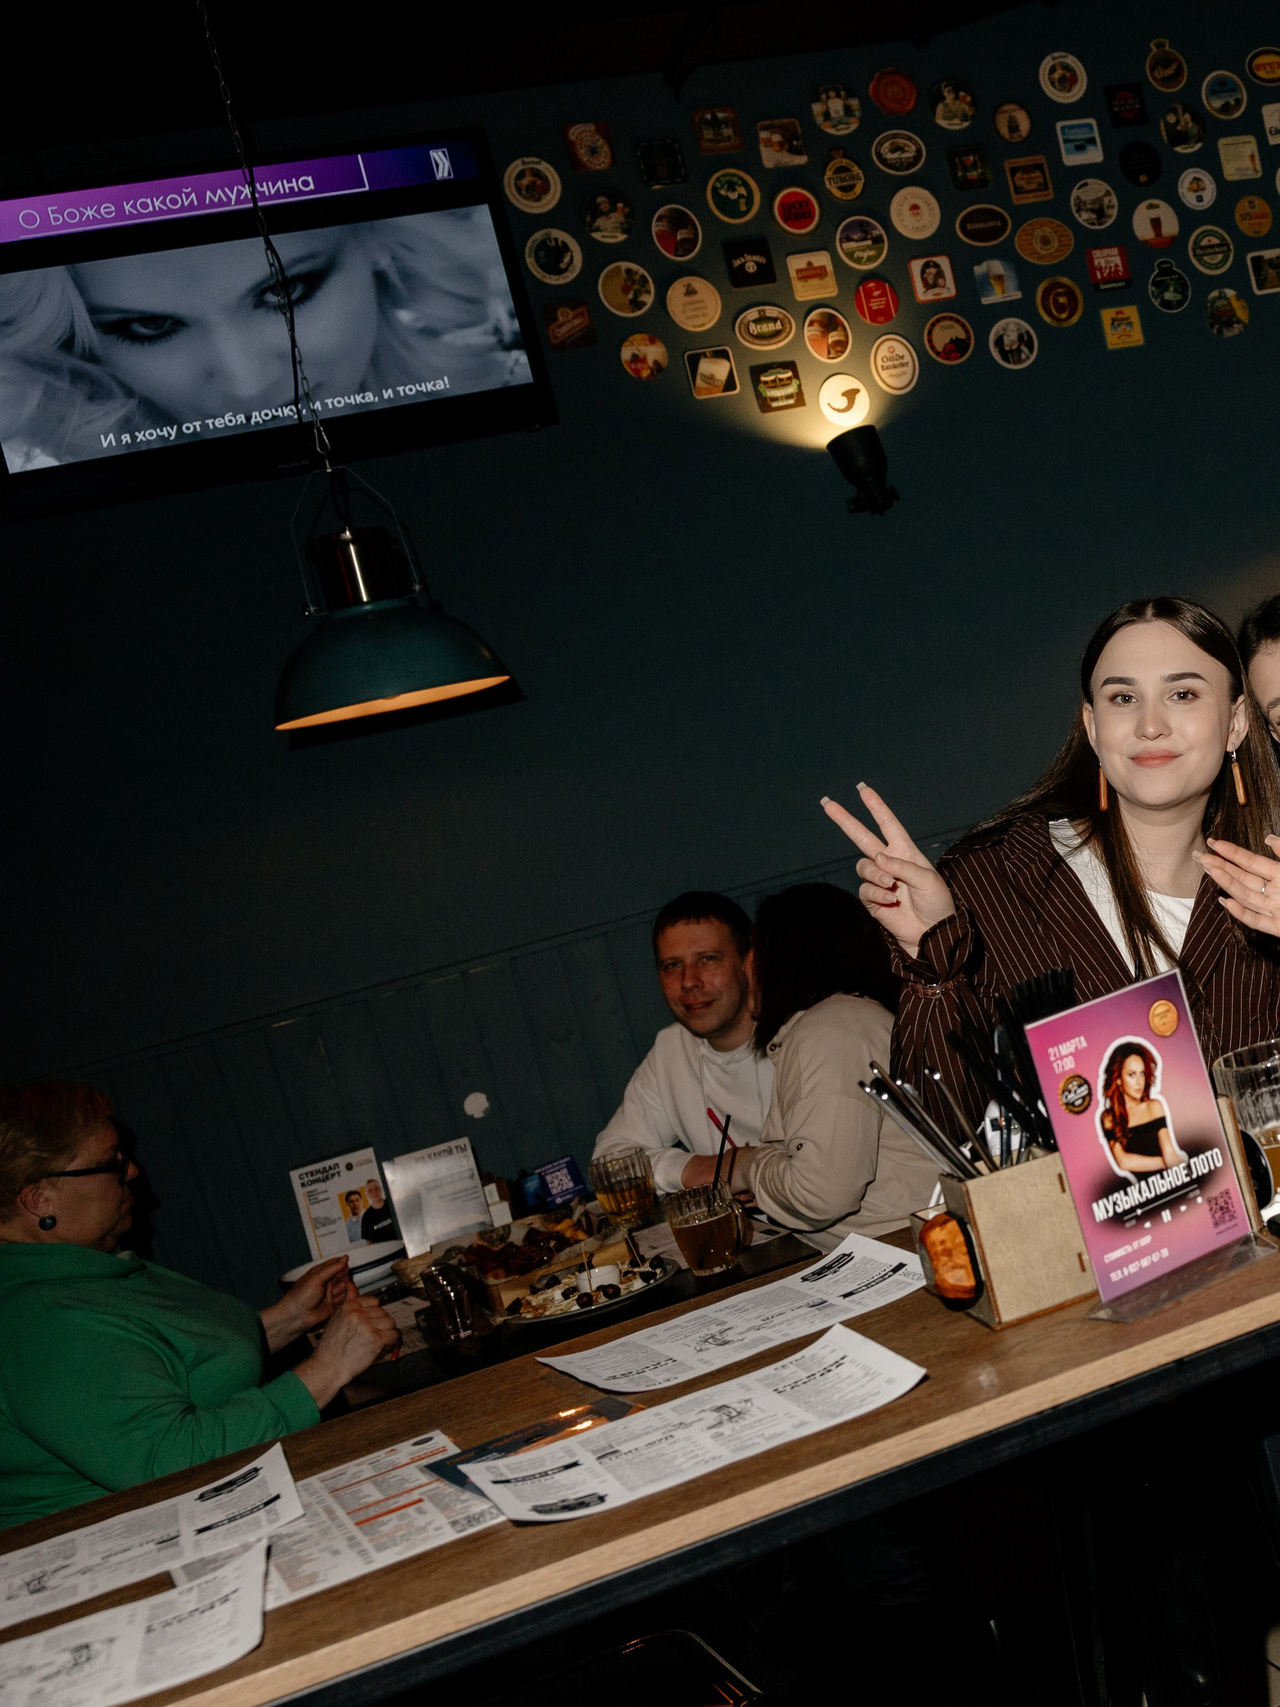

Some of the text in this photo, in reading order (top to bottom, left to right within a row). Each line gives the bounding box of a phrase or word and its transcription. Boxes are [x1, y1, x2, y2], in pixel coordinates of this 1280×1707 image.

[18, 174, 316, 229] О Боже какой мужчина
[782, 200, 811, 213] LUCKY
[749, 320, 783, 335] Brand
[100, 433, 116, 448] И
[121, 432, 131, 445] я
[134, 424, 177, 440] хочу
[182, 421, 202, 434] от
[204, 412, 246, 430] тебя
[325, 391, 378, 410] точка,
[382, 388, 394, 400] и
[396, 376, 450, 397] точка!
[1047, 1035, 1089, 1062] 21 МАРТА
[454, 1143, 467, 1155] ТЫ
[298, 1162, 340, 1180] СТЕНДАП
[300, 1170, 341, 1189] КОНЦЕРТ
[1091, 1147, 1224, 1223] МУЗЫКАЛЬНОЕ ЛОТО
